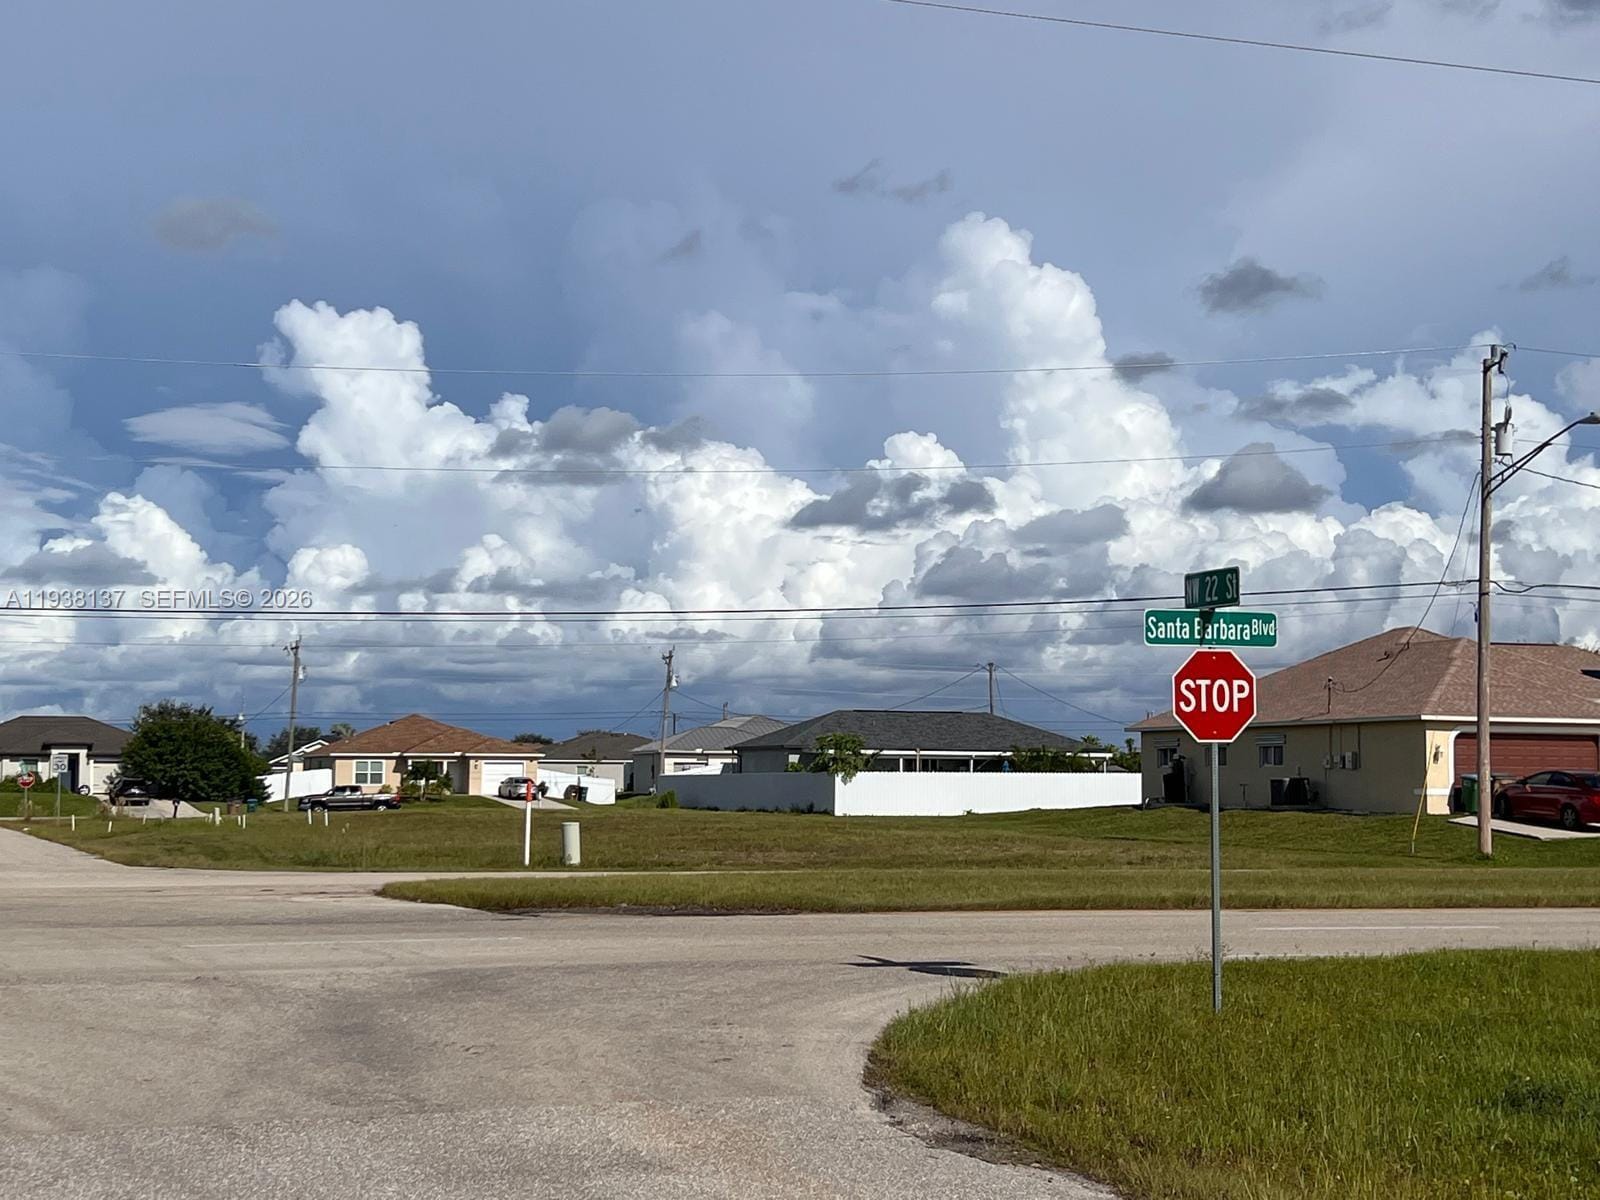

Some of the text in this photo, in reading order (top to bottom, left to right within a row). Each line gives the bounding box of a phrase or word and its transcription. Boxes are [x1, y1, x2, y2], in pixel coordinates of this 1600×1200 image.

[1187, 573, 1237, 604] NW 22 St
[1147, 616, 1275, 641] Santa Barbara Blvd
[1179, 678, 1250, 713] STOP
